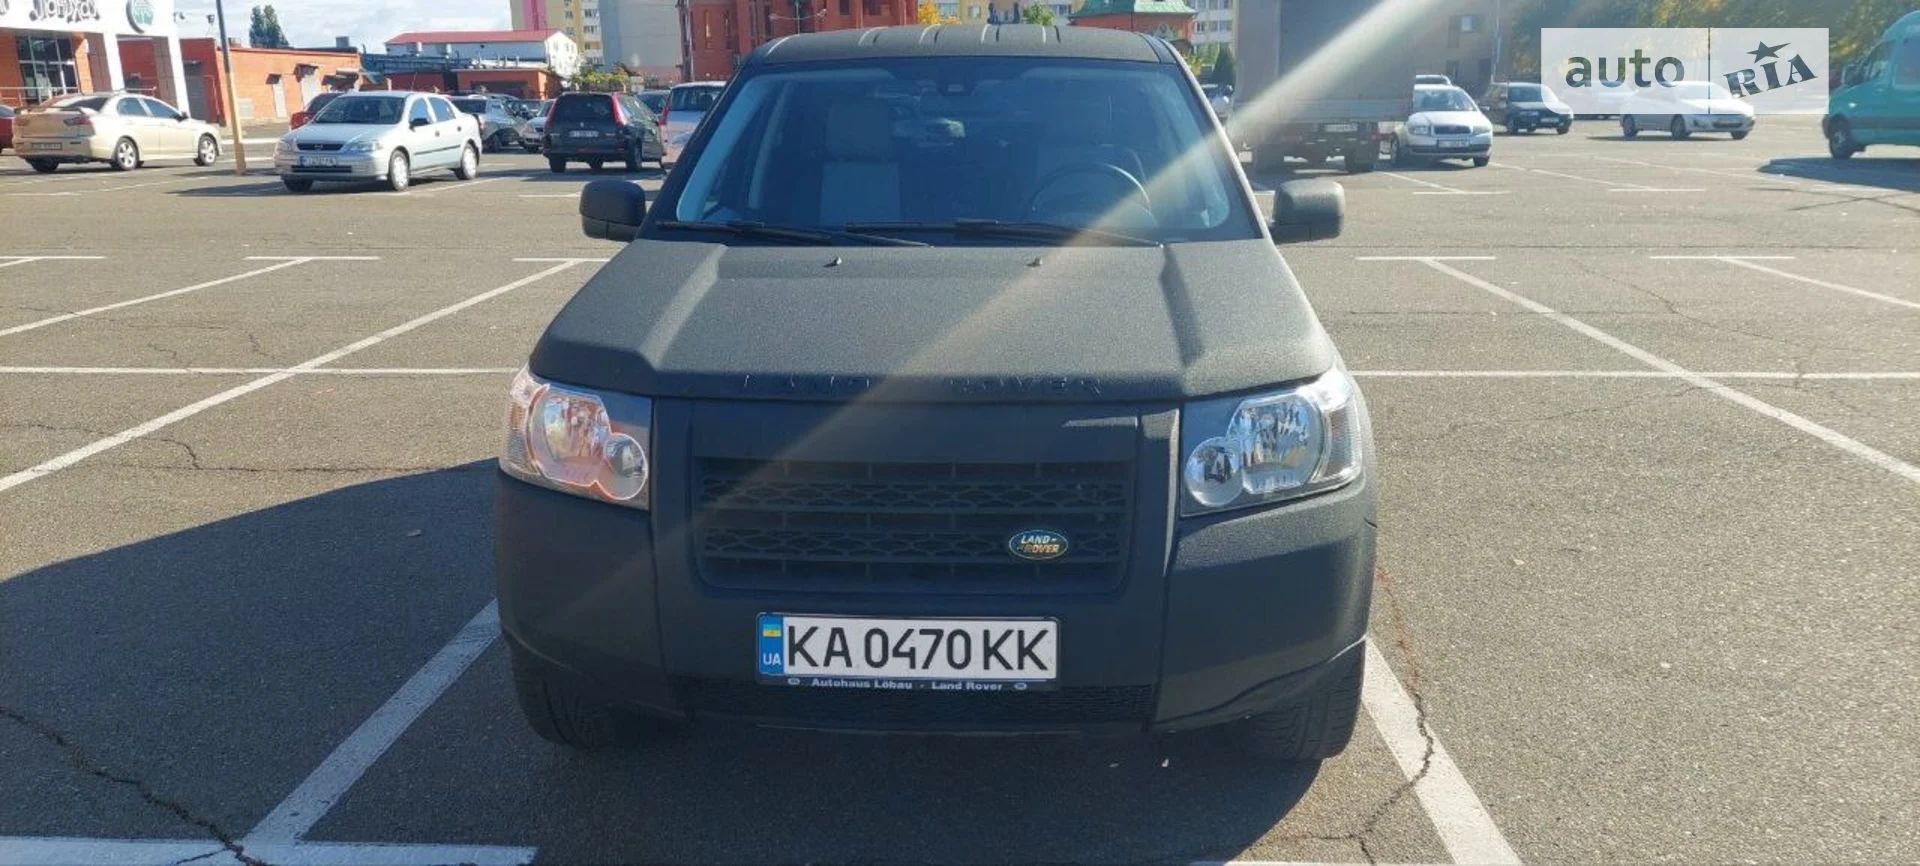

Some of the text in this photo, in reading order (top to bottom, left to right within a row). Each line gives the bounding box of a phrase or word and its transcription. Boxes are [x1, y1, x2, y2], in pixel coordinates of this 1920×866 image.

[788, 625, 1050, 671] KA 0470 KK
[762, 652, 782, 666] UA
[812, 678, 870, 688] Autohaus
[931, 681, 962, 691] Land
[966, 682, 1003, 691] Rover
